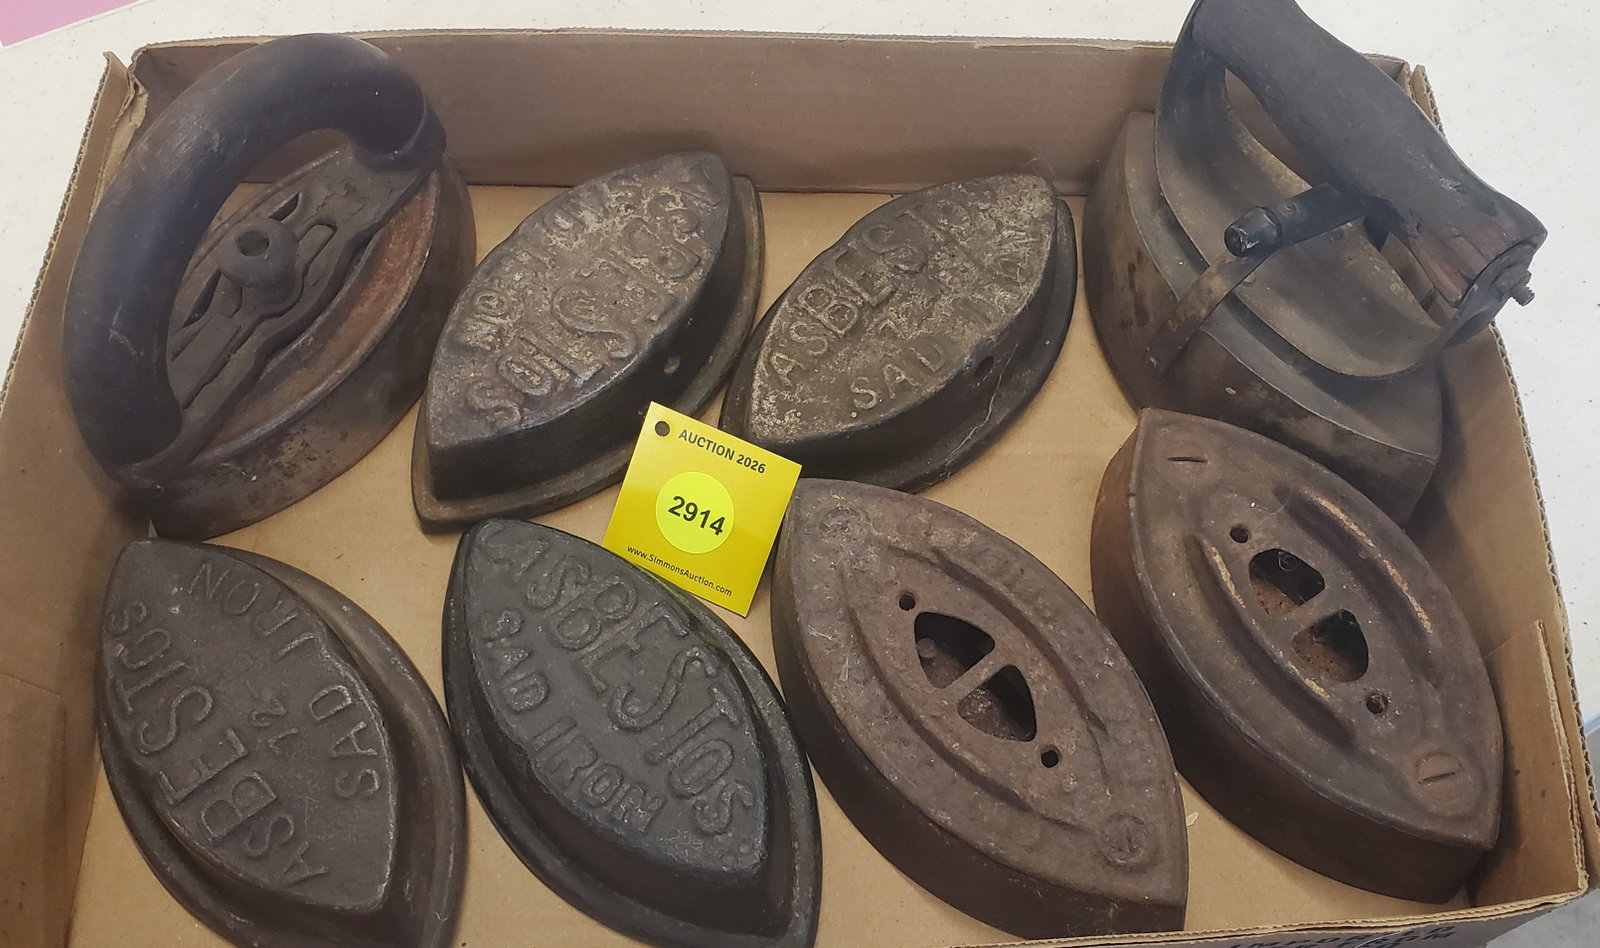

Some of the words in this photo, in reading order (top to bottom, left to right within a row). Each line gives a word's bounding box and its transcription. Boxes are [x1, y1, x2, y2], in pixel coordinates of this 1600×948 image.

[848, 340, 950, 414] SAD
[678, 429, 736, 461] AUCTION
[736, 454, 766, 474] 2026
[668, 495, 726, 536] 2914
[181, 561, 317, 661] IRON
[627, 545, 733, 597] www.SimmonsAuction.com
[480, 605, 555, 712] SAD
[530, 713, 670, 835] IRON
[484, 523, 756, 836] ASBESTOS
[105, 597, 329, 881] ASBESTOS
[304, 683, 384, 798] SAD
